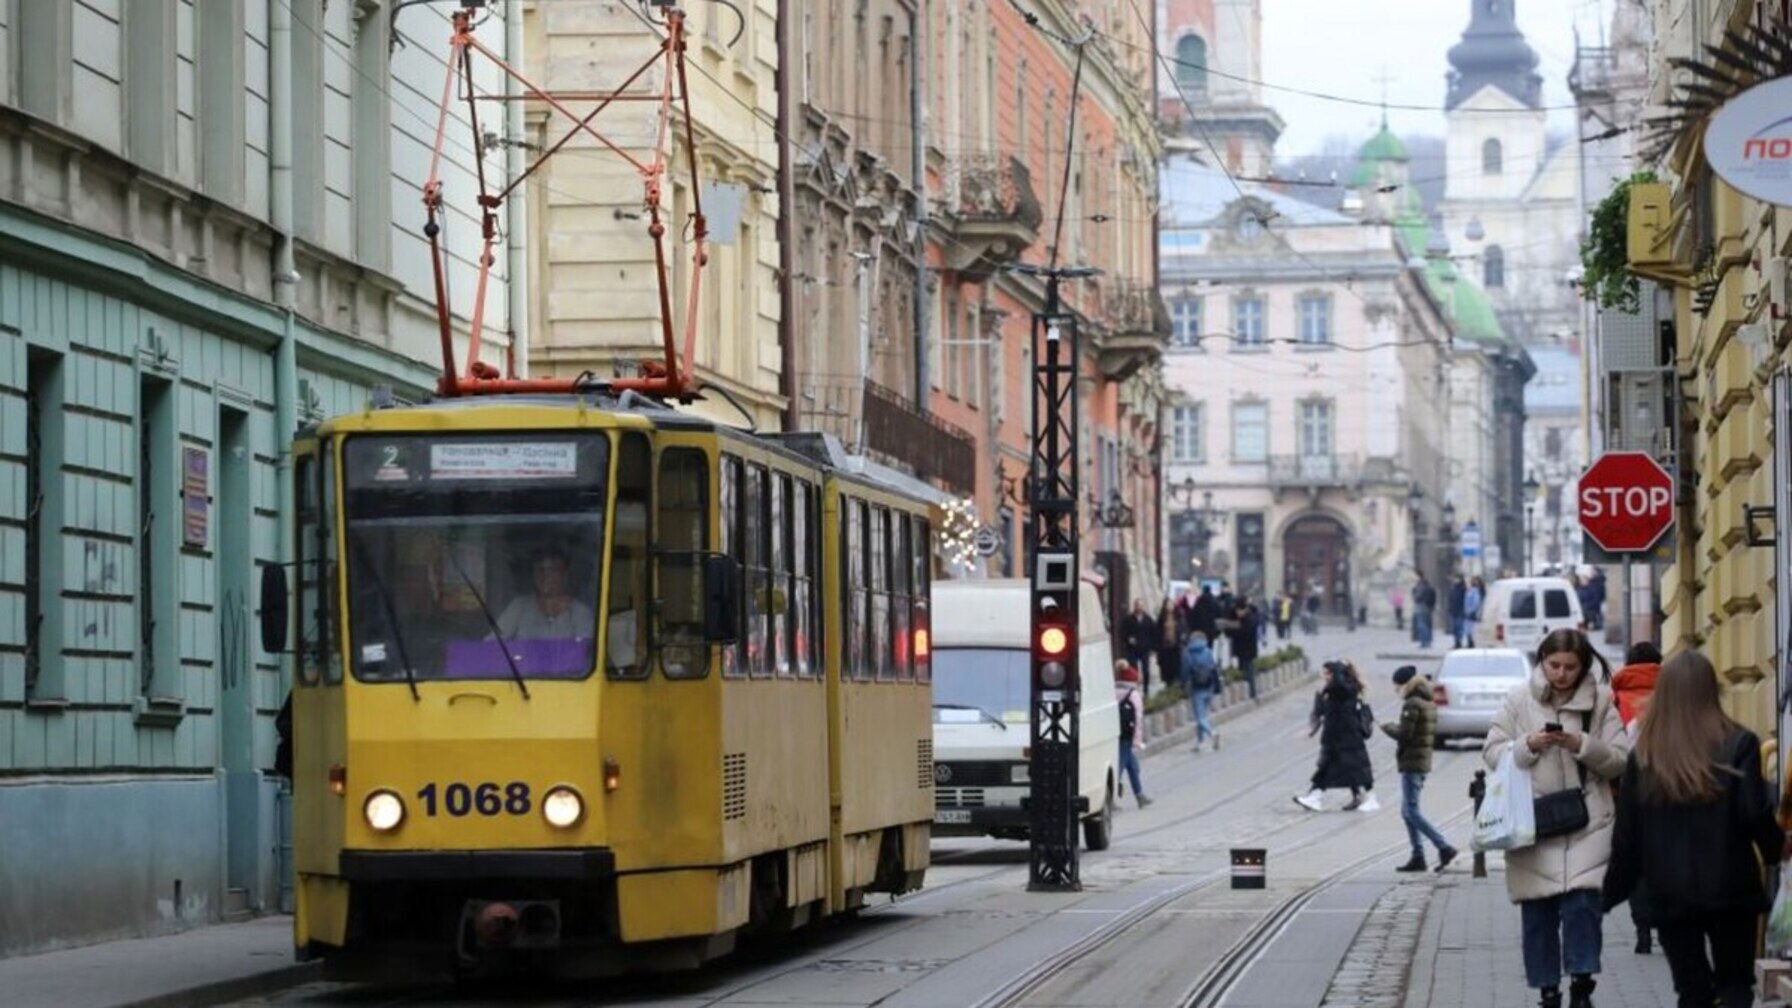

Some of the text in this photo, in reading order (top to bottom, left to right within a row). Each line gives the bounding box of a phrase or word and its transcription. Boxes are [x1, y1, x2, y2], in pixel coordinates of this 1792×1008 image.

[1743, 138, 1792, 159] ПО
[383, 445, 399, 467] 2
[1582, 486, 1670, 517] STOP
[417, 782, 532, 817] 1068
